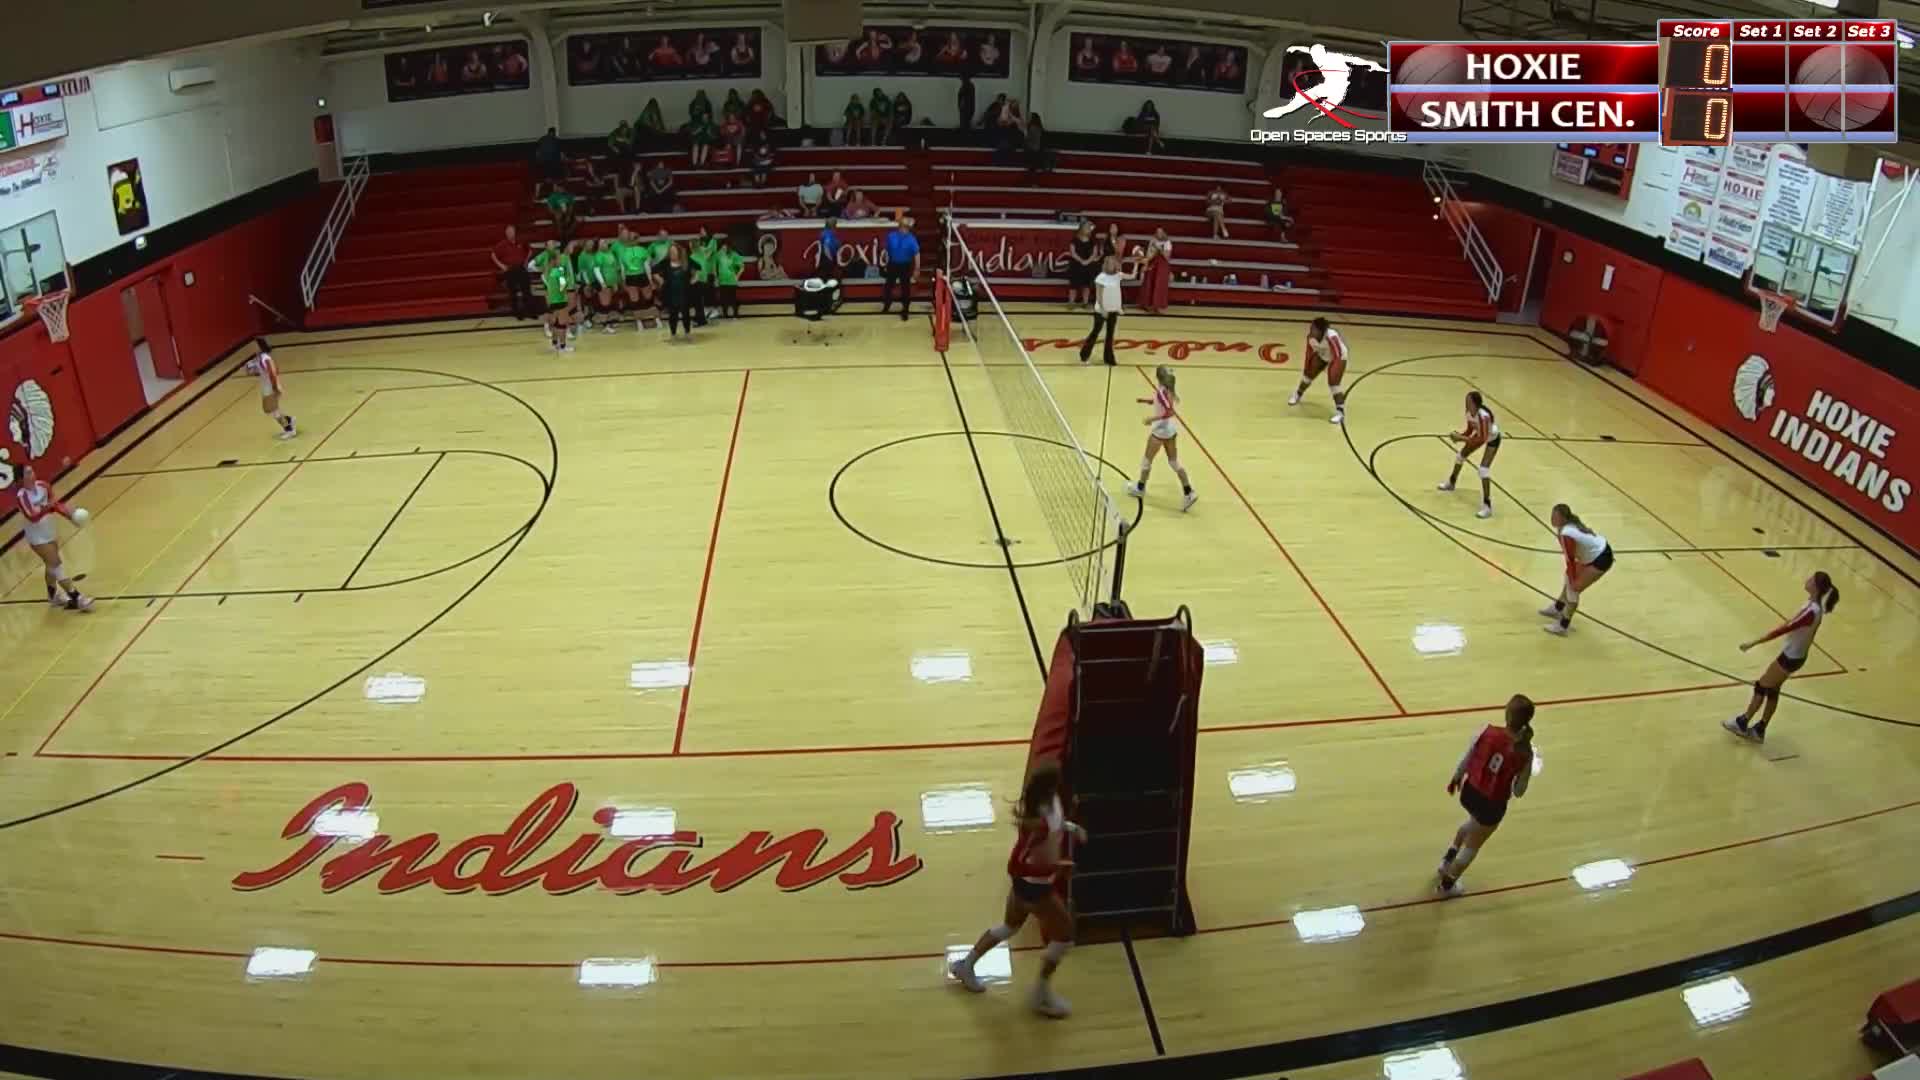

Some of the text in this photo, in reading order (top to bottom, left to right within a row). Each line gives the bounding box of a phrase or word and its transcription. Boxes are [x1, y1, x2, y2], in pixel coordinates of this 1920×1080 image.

[1723, 180, 1762, 200] HOXIE
[1769, 409, 1912, 512] INDIANS
[1806, 390, 1896, 458] HOXIE
[232, 782, 923, 896] Indians
